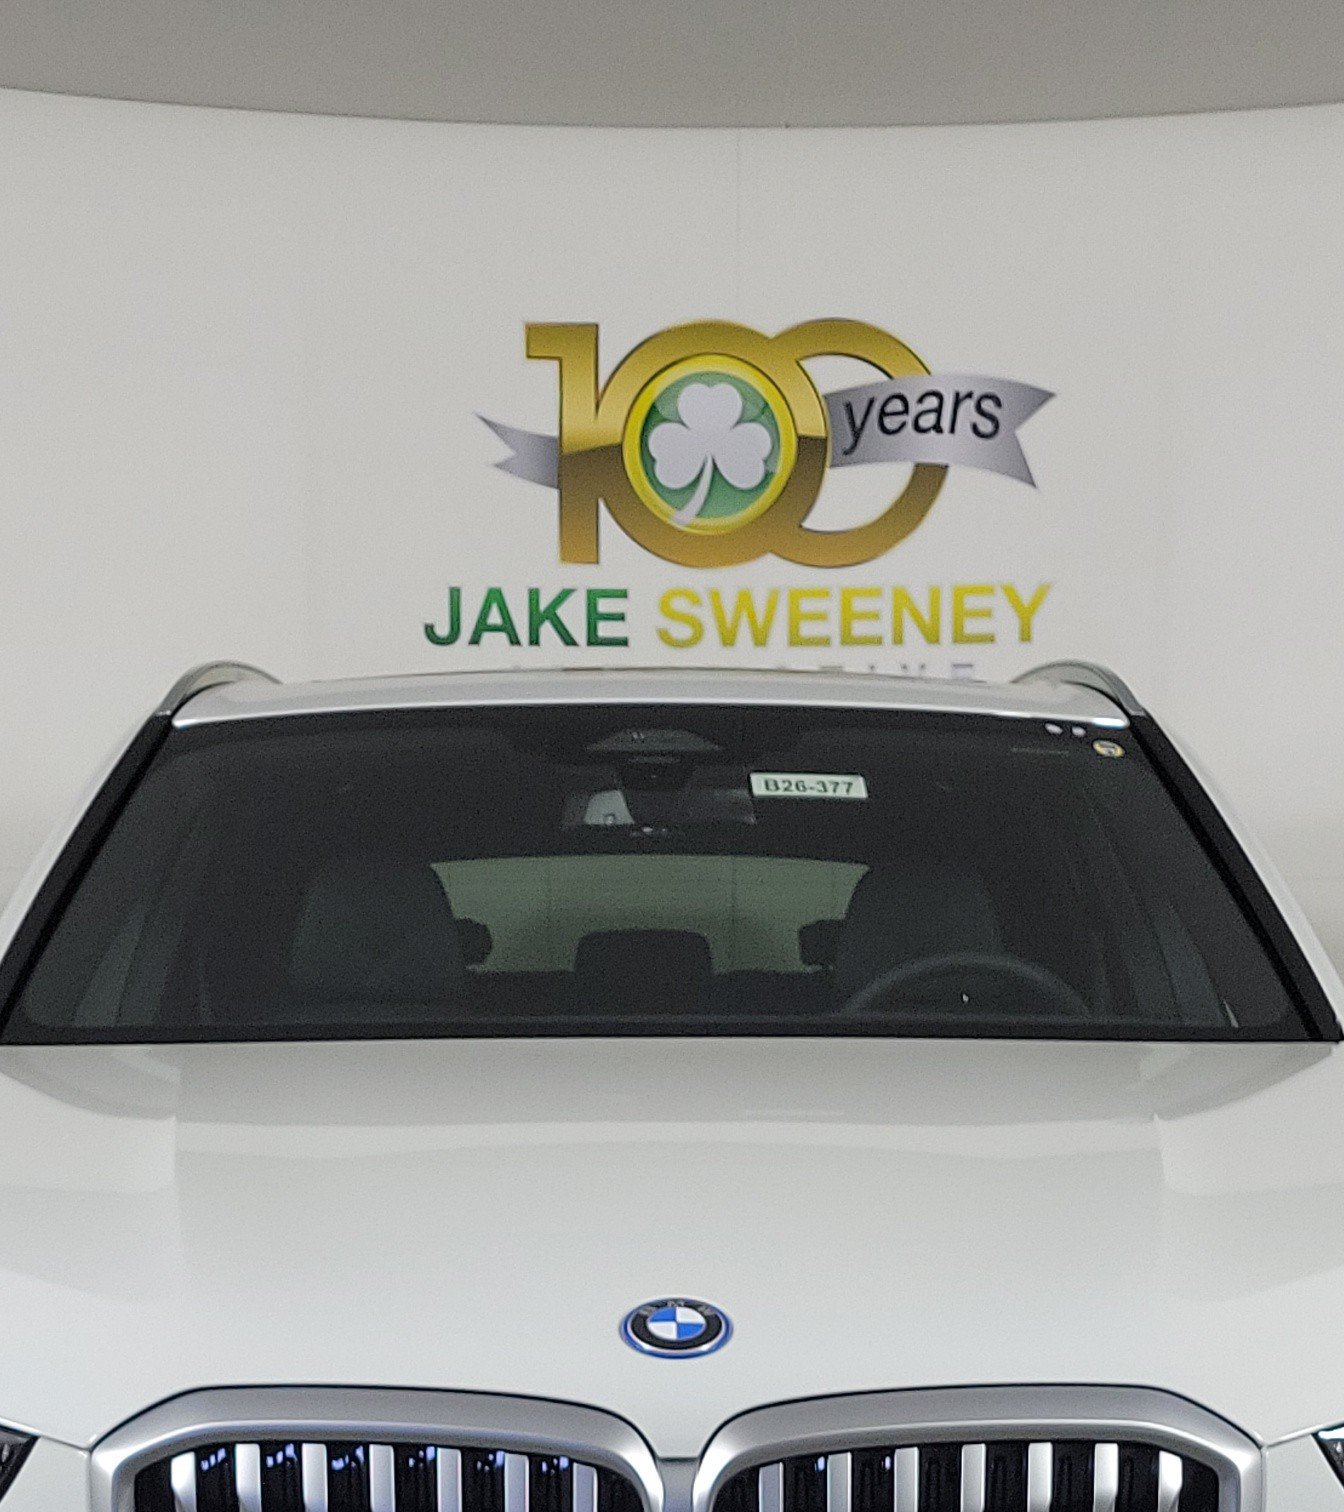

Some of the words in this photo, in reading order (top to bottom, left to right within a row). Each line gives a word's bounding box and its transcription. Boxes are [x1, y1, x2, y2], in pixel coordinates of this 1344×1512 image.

[524, 317, 950, 569] 100
[840, 386, 1003, 457] years
[422, 586, 630, 648] JAKE
[656, 583, 1052, 648] SWEENEY
[763, 778, 854, 796] B26-377
